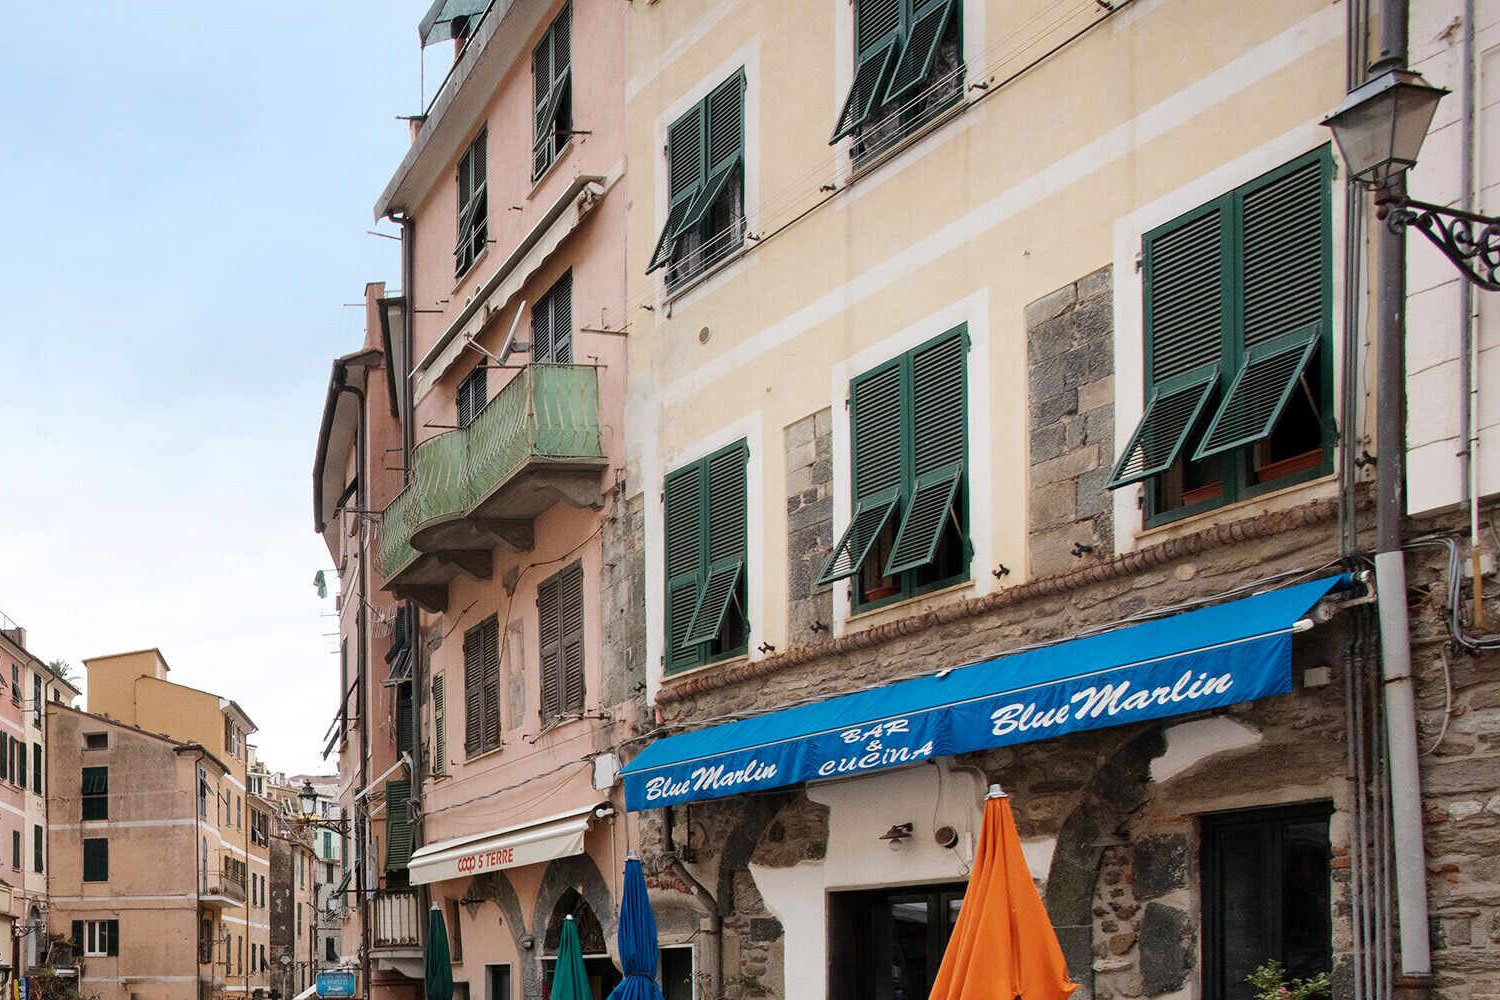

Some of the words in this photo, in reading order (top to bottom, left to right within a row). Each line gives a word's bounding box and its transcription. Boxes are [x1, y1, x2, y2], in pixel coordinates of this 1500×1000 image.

[990, 702, 1069, 736] Blue
[1071, 670, 1233, 720] Marlin
[840, 719, 910, 744] BAR
[865, 739, 883, 752] &
[645, 776, 690, 801] Blue
[690, 759, 778, 792] Marlin
[478, 854, 483, 868] 5
[486, 847, 514, 867] TERRE
